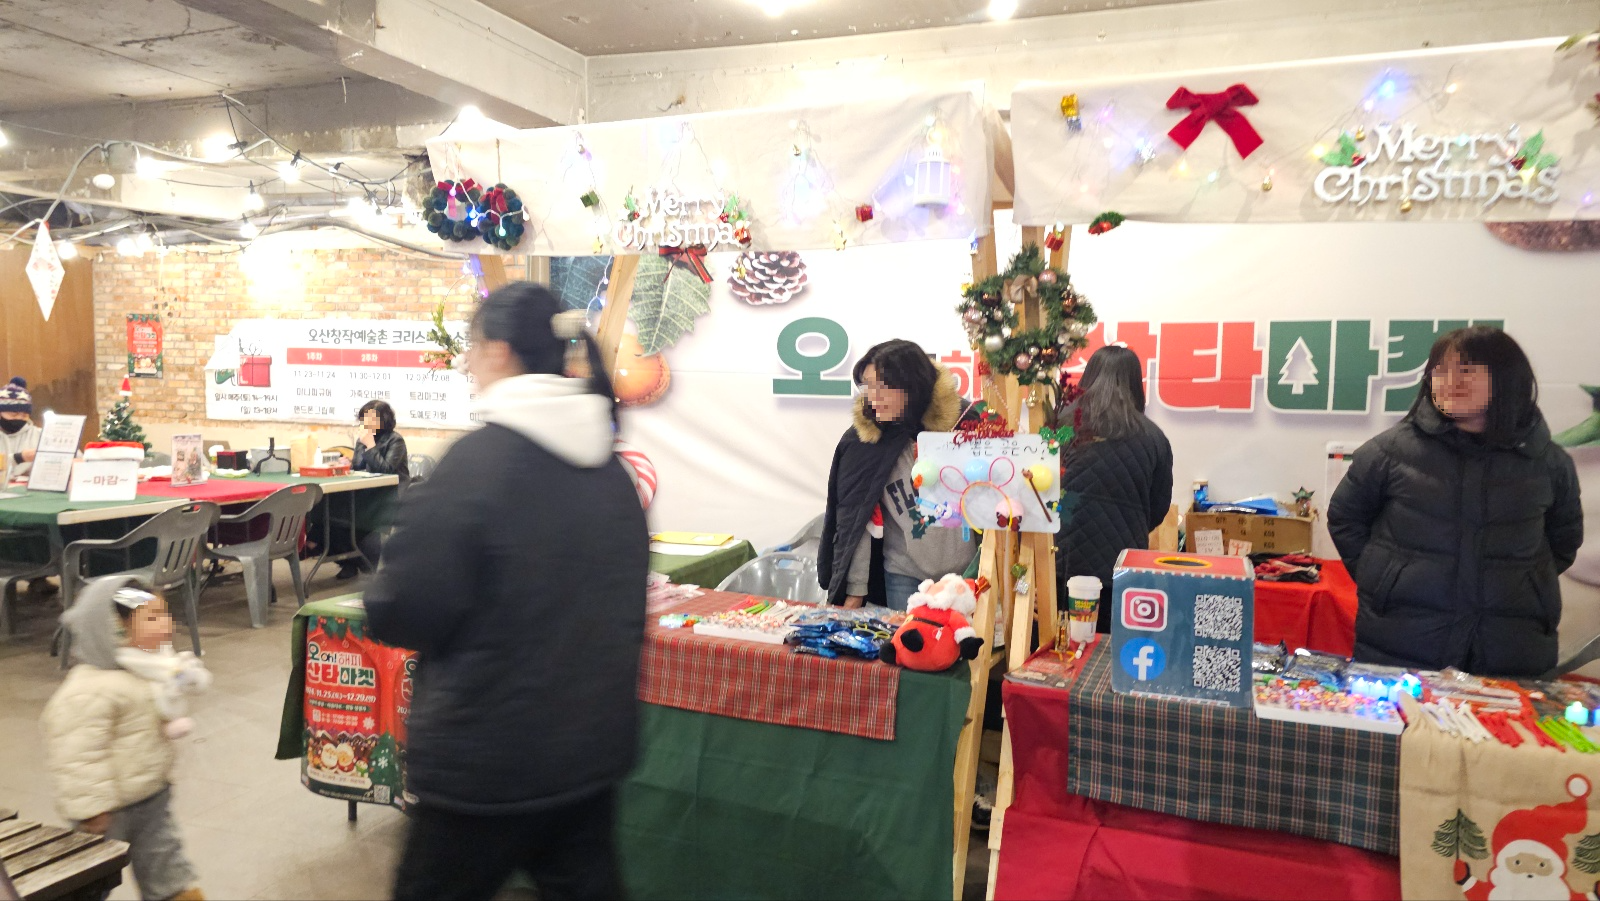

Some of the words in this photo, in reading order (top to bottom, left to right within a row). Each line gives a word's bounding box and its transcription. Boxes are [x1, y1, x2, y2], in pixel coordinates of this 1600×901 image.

[1366, 121, 1521, 169] Merry
[1313, 163, 1562, 207] Christmas
[612, 215, 748, 251] Christma
[308, 328, 388, 345] 오산창작예술촌
[306, 352, 323, 361] 1주차
[361, 353, 378, 362] 2주차
[773, 316, 852, 397] 오
